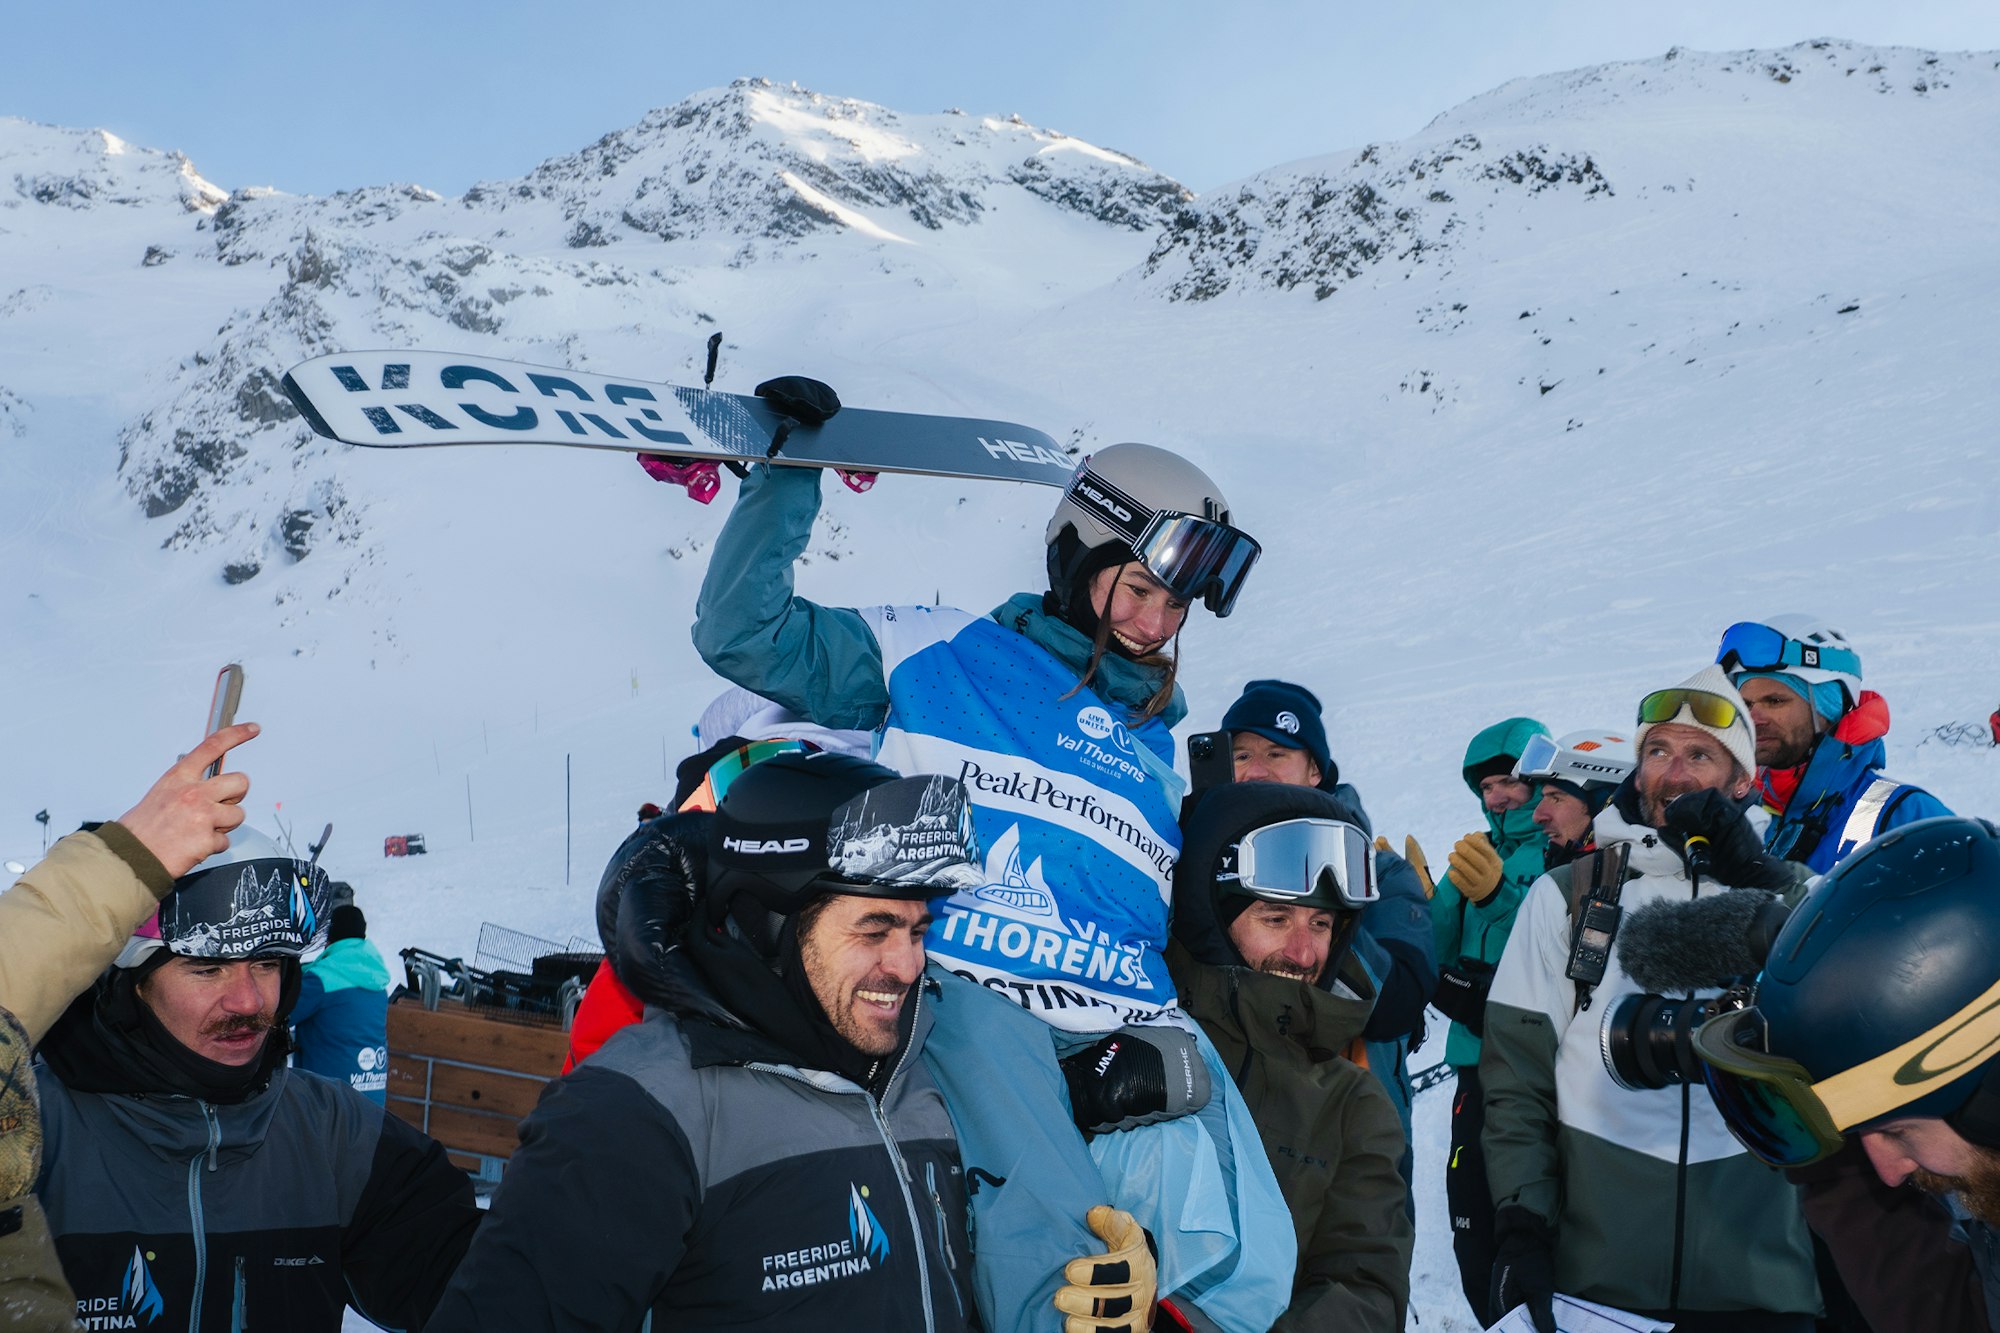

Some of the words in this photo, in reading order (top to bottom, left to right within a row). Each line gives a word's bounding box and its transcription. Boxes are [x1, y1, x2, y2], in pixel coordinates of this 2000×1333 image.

[330, 363, 693, 447] KORE
[977, 436, 1077, 471] HEAD
[1077, 482, 1132, 522] HEAD
[1079, 718, 1110, 733] UNITED
[1088, 713, 1105, 724] LIVE
[1056, 732, 1084, 752] Val
[1084, 741, 1146, 783] Thorens
[1570, 761, 1625, 774] SCOTT
[723, 836, 810, 853] HEAD
[901, 831, 958, 844] FREERIDE
[895, 843, 966, 860] ARGENTINA
[222, 918, 292, 940] FREERIDE
[220, 931, 304, 954] ARGENTINA
[941, 906, 1137, 987] THORENS
[1095, 1049, 1116, 1077] FWT
[273, 1257, 307, 1266] DUKE
[762, 1239, 852, 1272] FREERIDE
[761, 1255, 872, 1292] ARGENTINA
